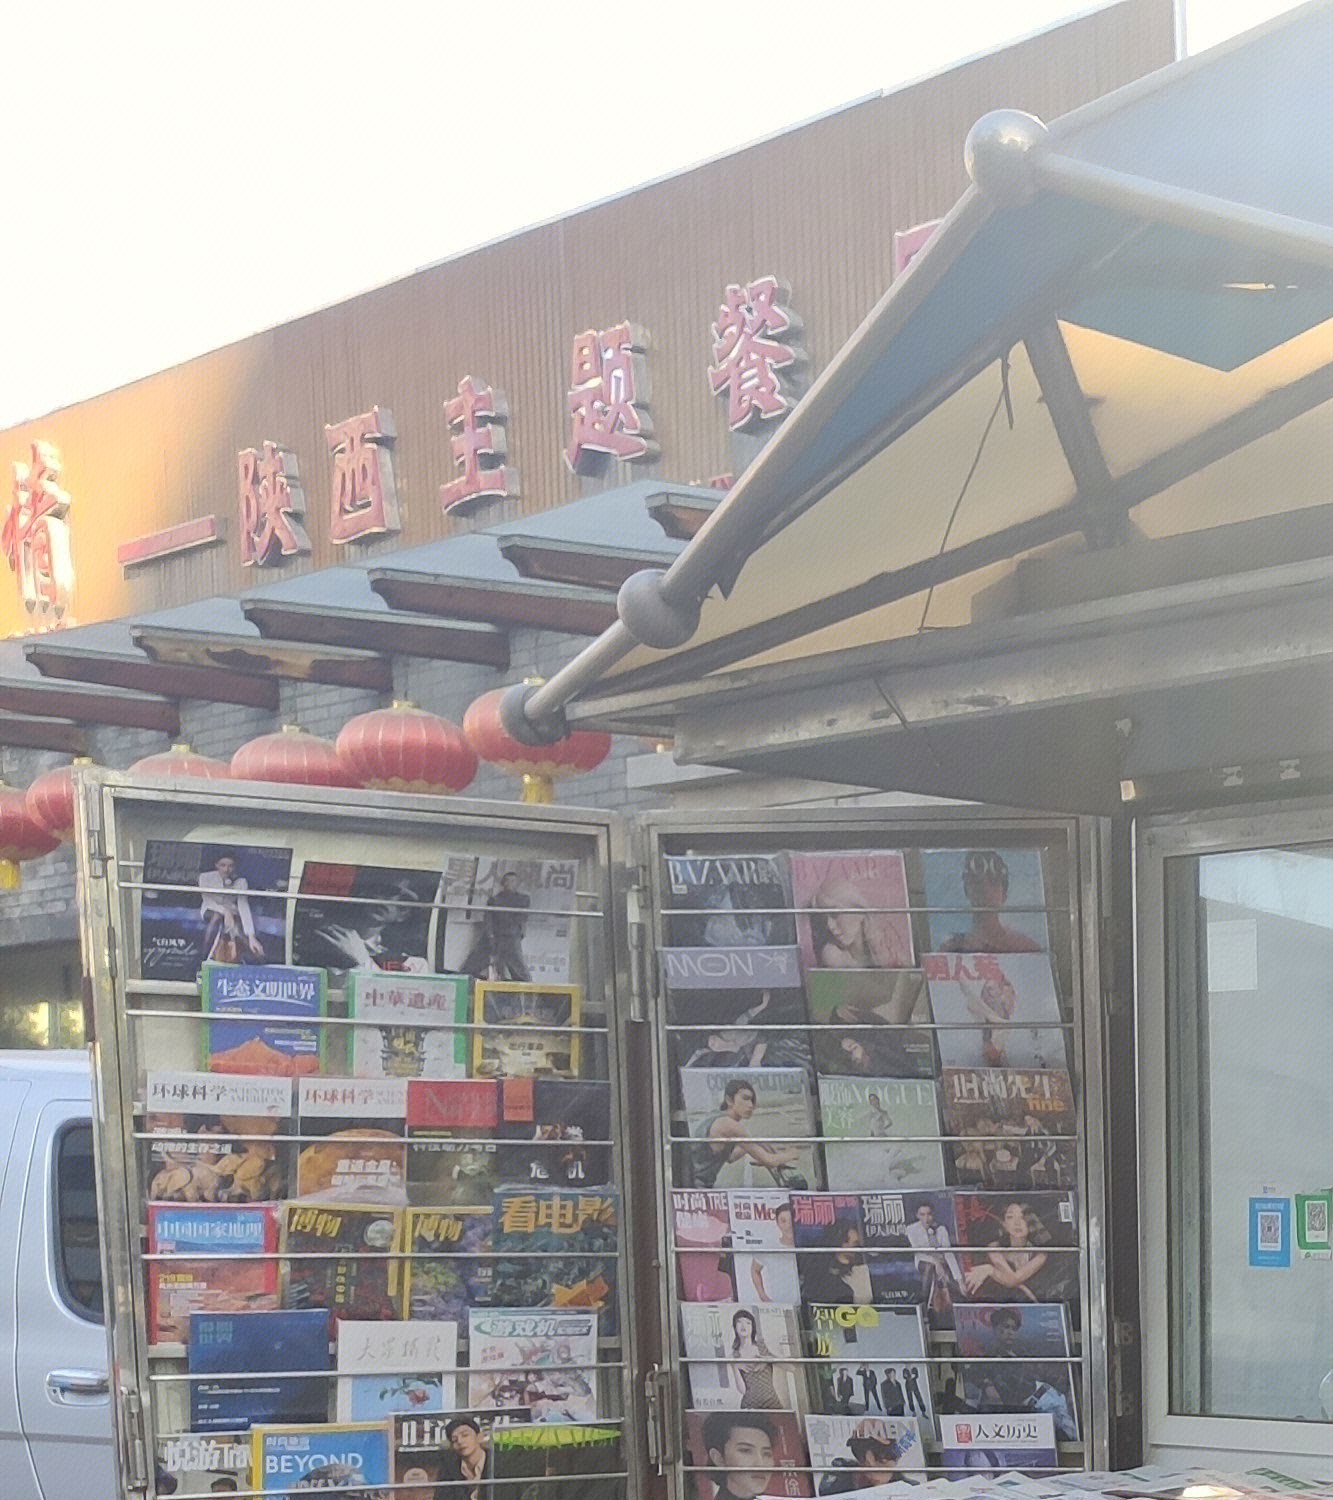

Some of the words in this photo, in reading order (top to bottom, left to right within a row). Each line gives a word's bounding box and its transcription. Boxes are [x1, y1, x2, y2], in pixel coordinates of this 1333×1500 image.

[151, 1083, 228, 1102] 环球科学
[304, 1088, 374, 1105] 环球科学
[501, 1194, 619, 1235] 看电影
[792, 1196, 836, 1226] 瑞丽
[863, 1194, 907, 1225] 瑞丽
[489, 1318, 557, 1338] 游戏机
[974, 1422, 1038, 1441] 人文历史
[264, 1452, 363, 1475] BEYOND
